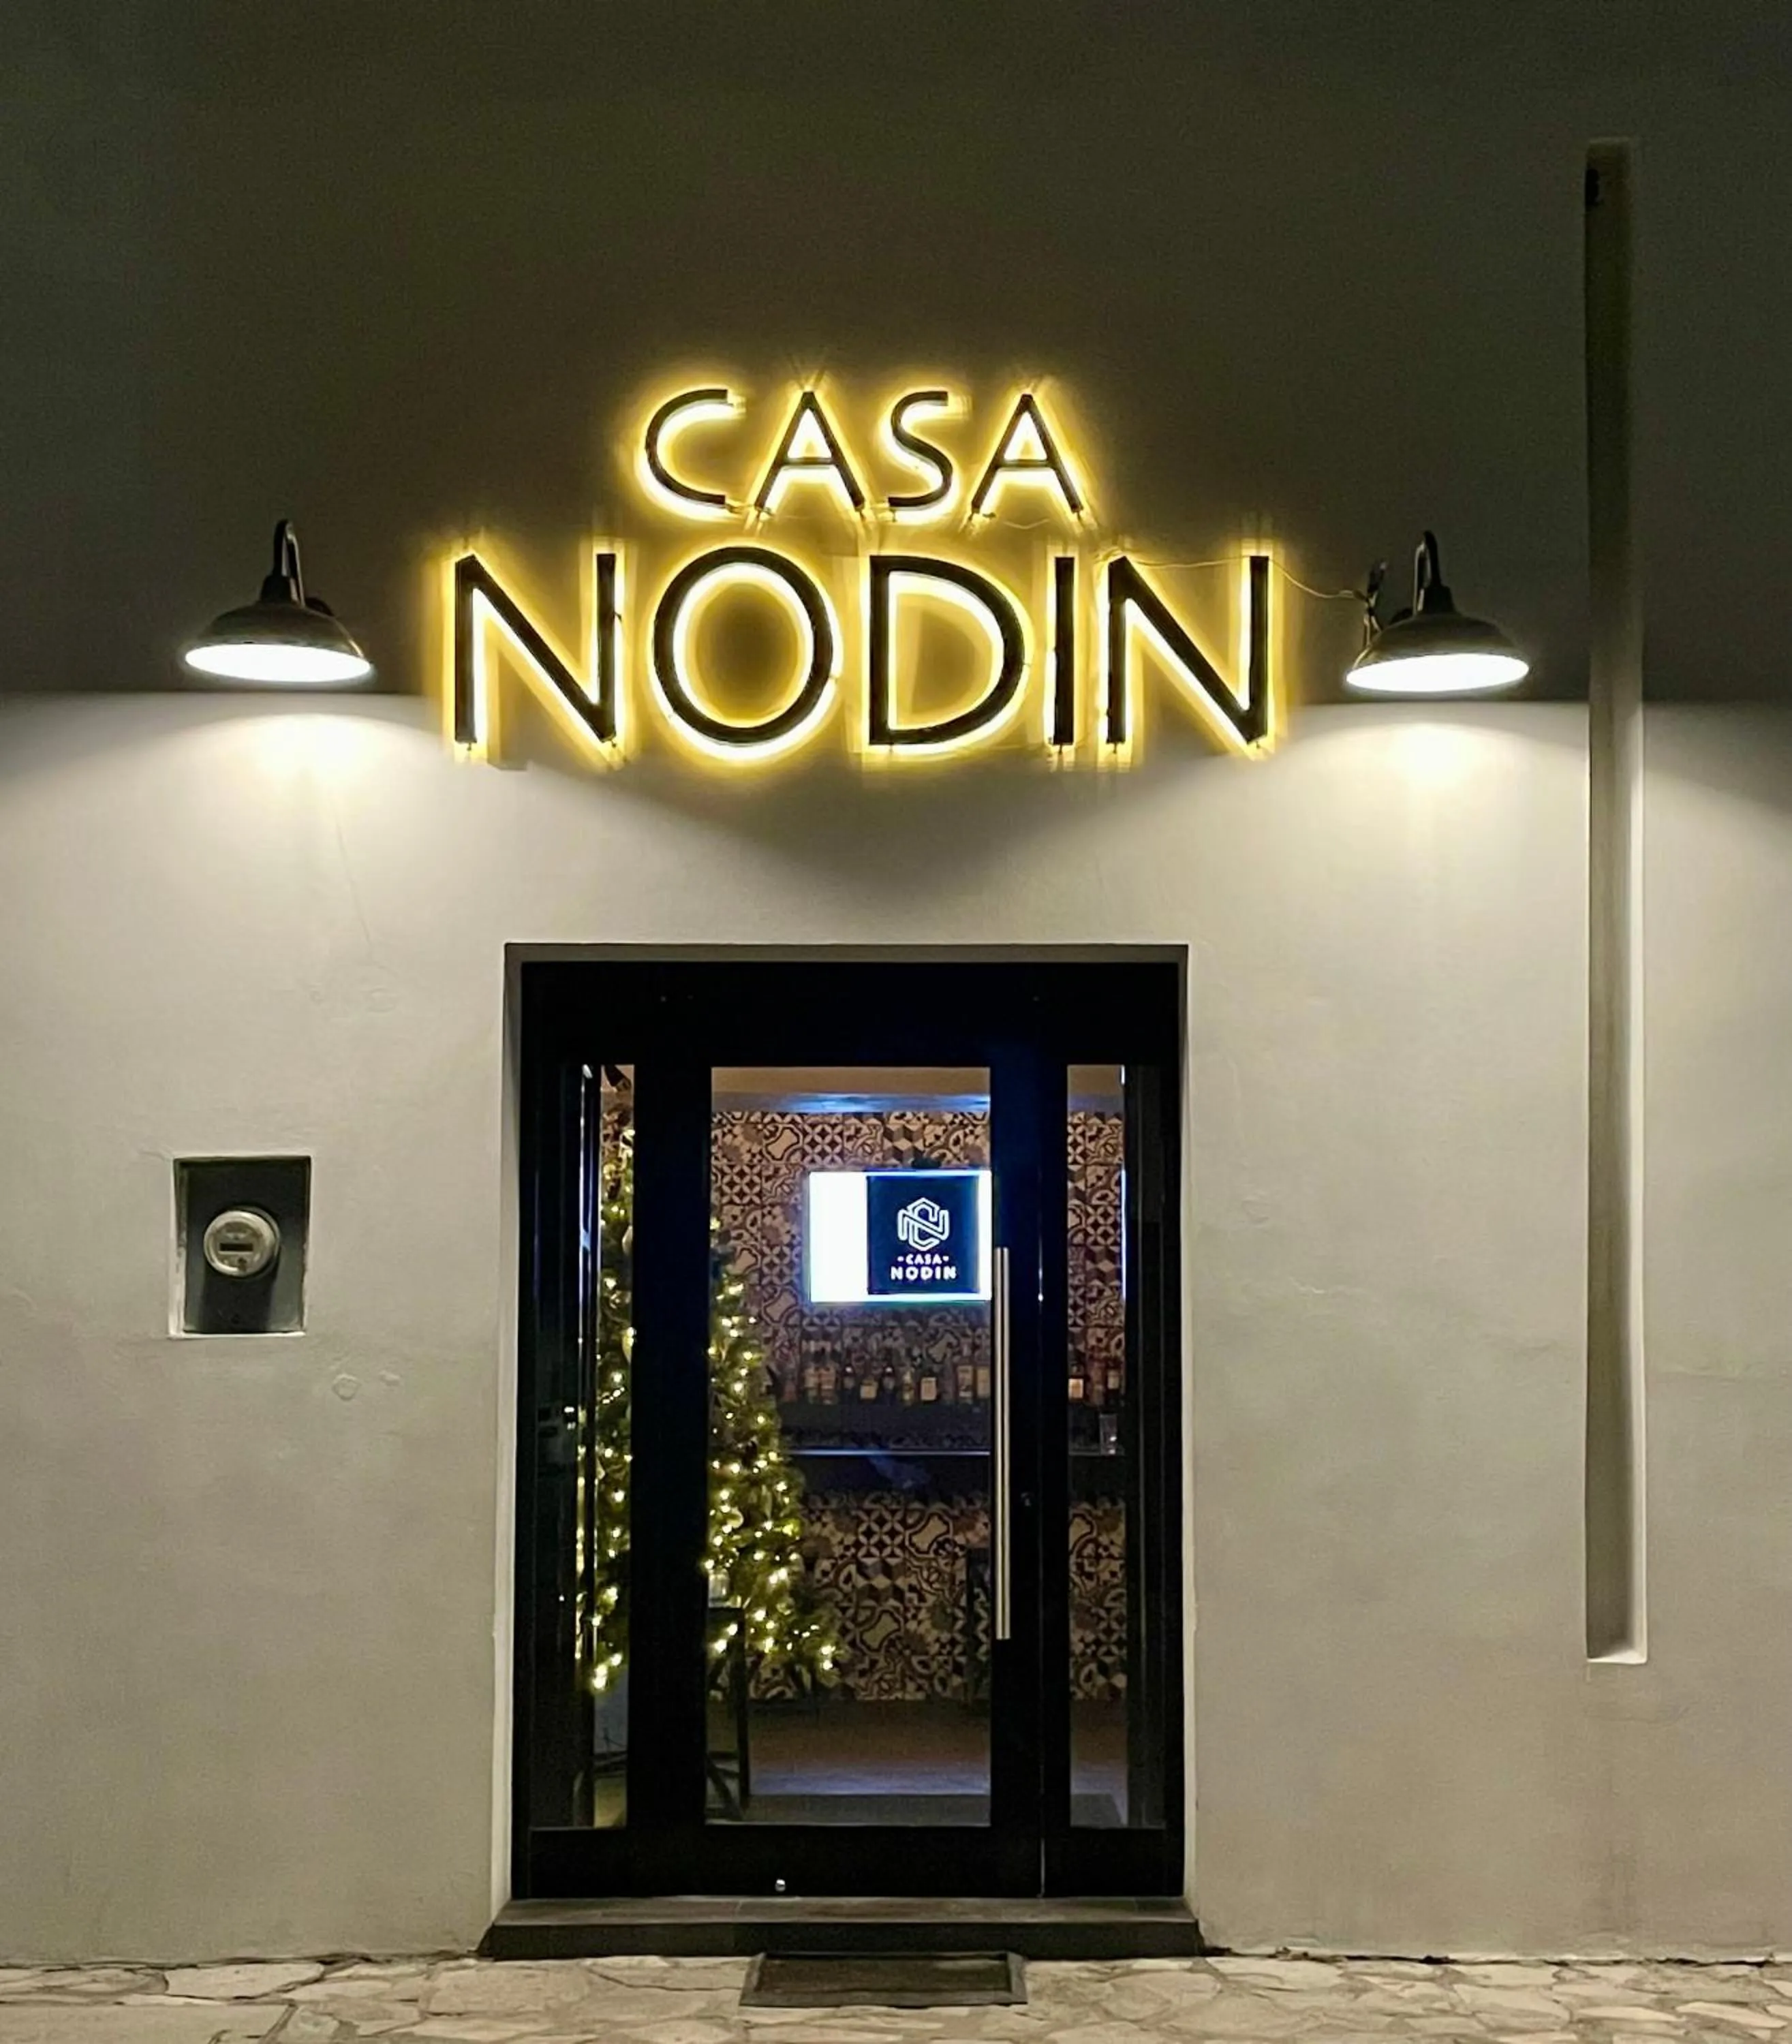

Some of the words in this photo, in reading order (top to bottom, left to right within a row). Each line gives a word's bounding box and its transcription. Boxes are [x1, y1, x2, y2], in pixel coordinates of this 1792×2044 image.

[644, 388, 1083, 513] CASA
[453, 546, 1269, 747] NODIN
[891, 1266, 957, 1280] NODIN
